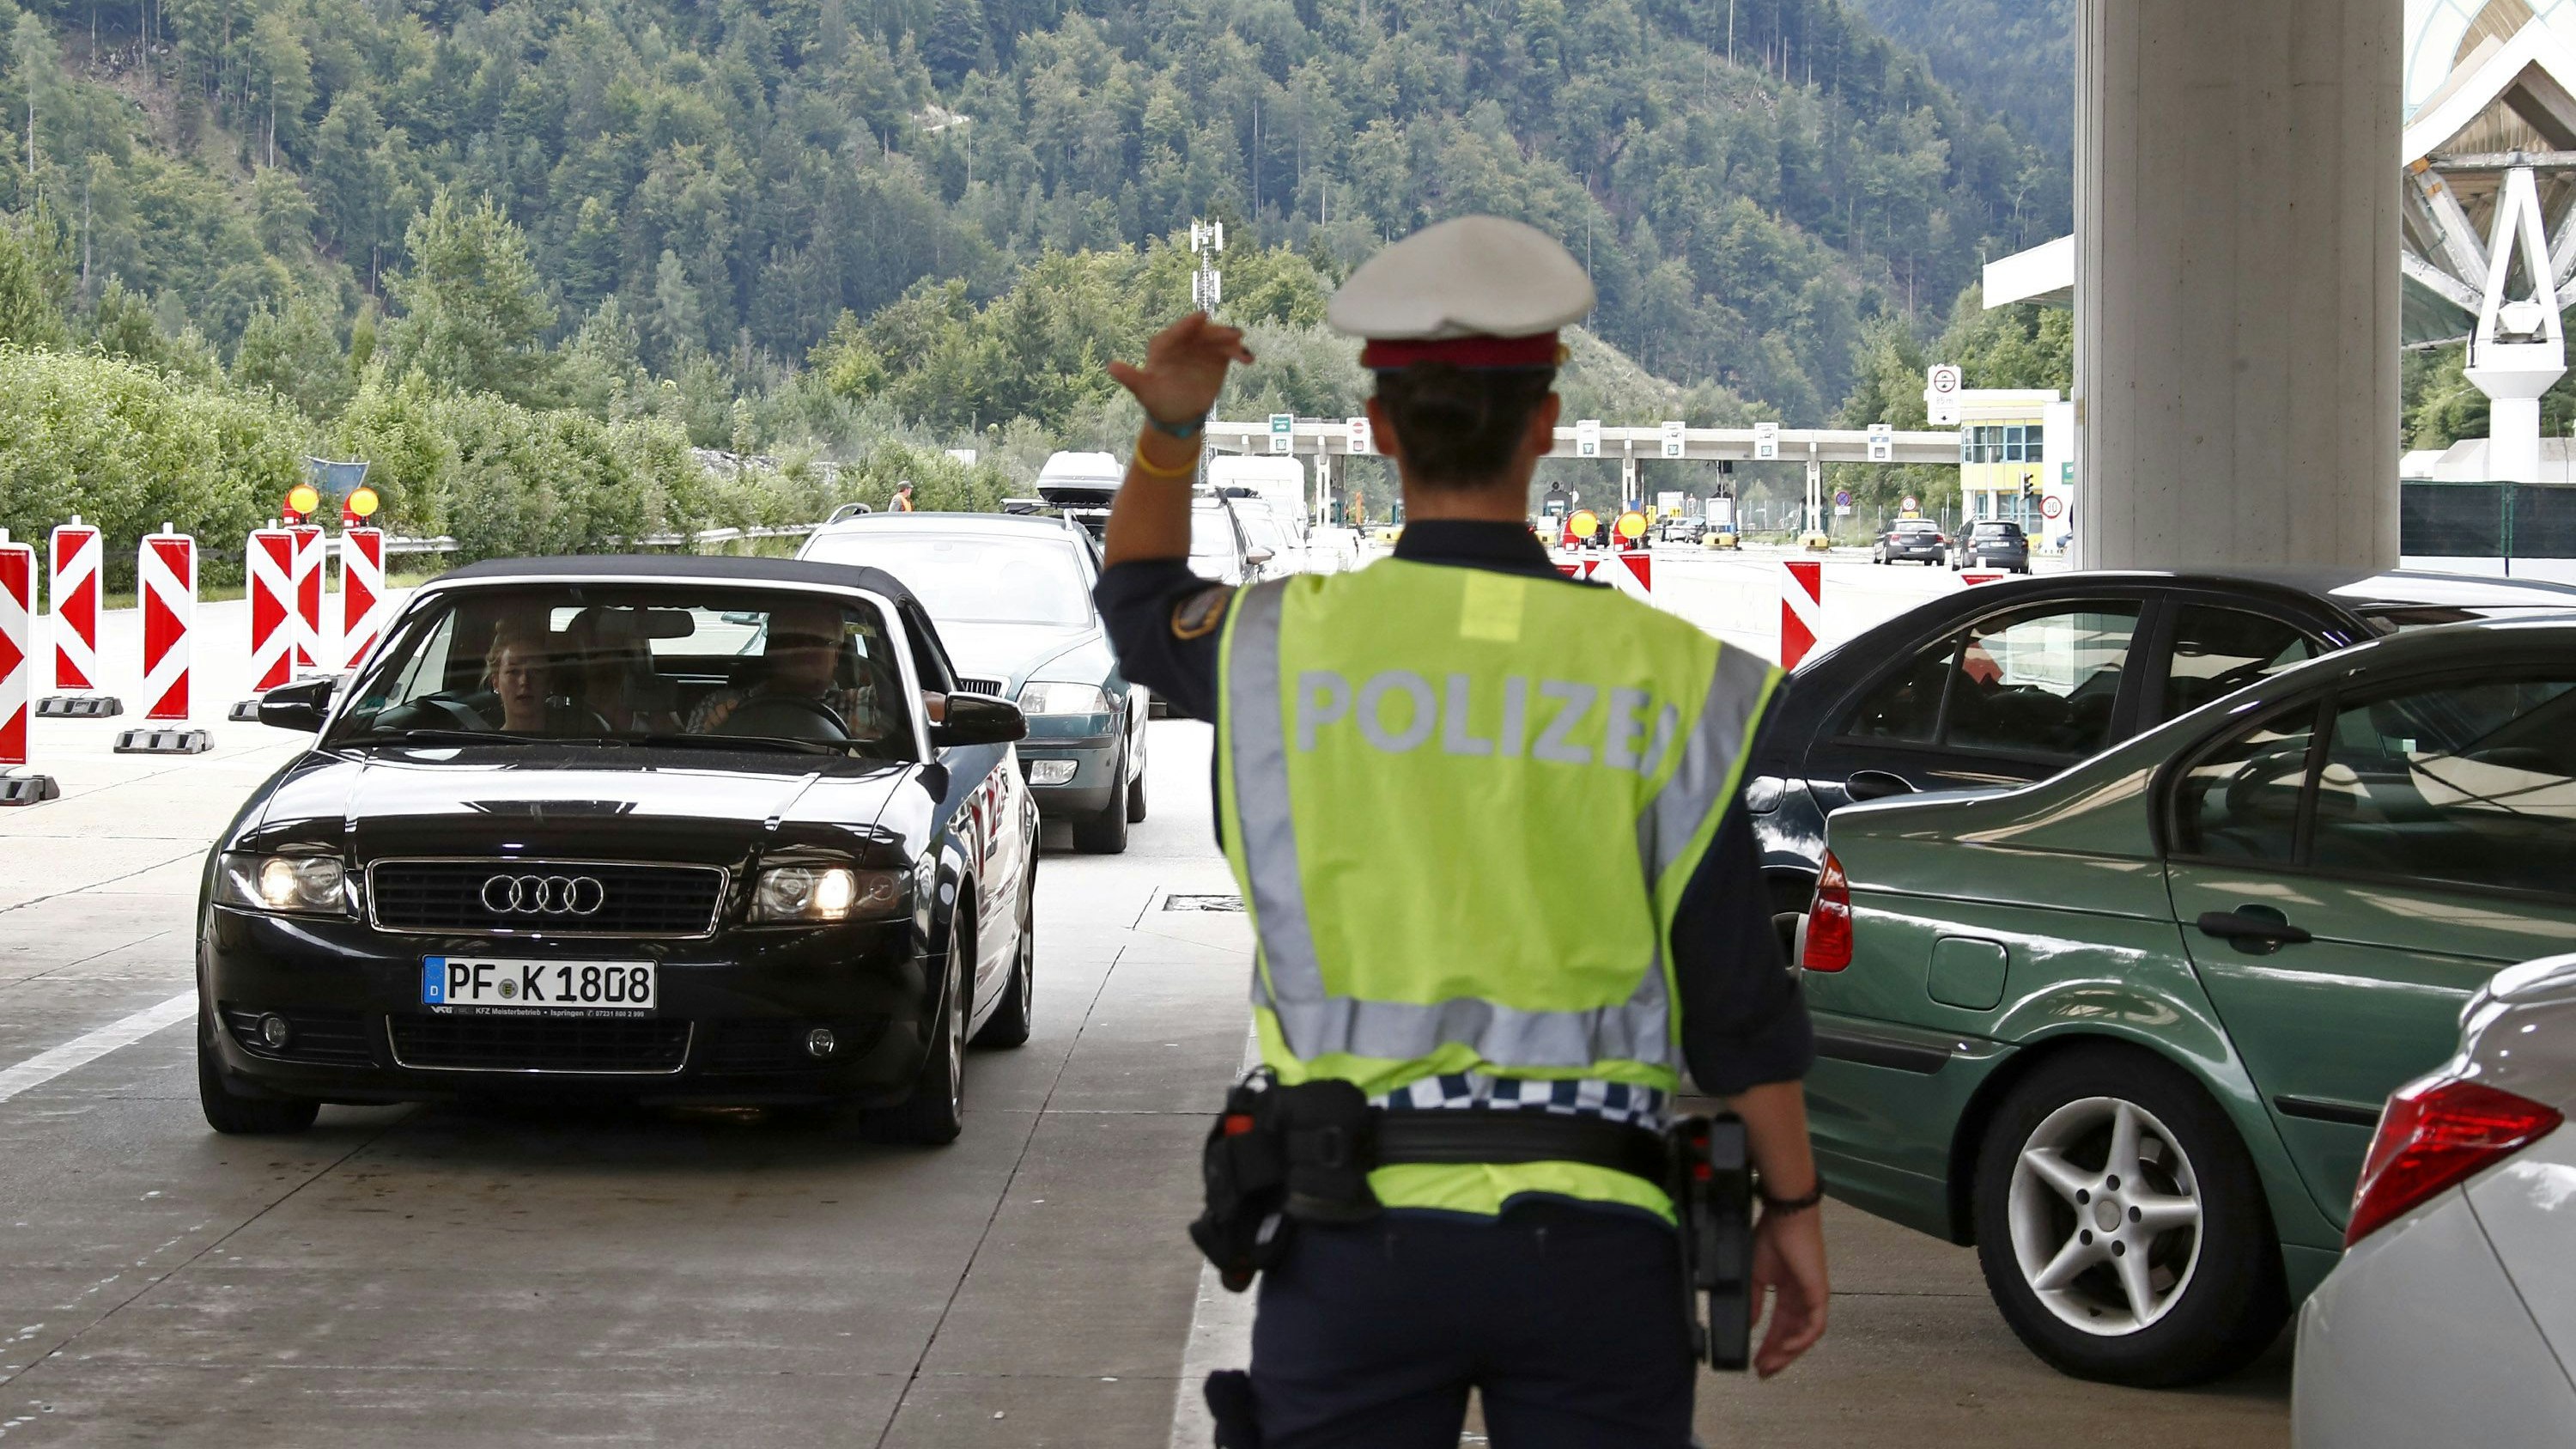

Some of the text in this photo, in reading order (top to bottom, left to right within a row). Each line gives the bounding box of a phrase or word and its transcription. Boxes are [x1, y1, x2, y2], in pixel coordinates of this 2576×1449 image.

[447, 963, 650, 1003] PF K 1808
[430, 985, 439, 995] D
[491, 1008, 541, 1016] Meisterbetrieb
